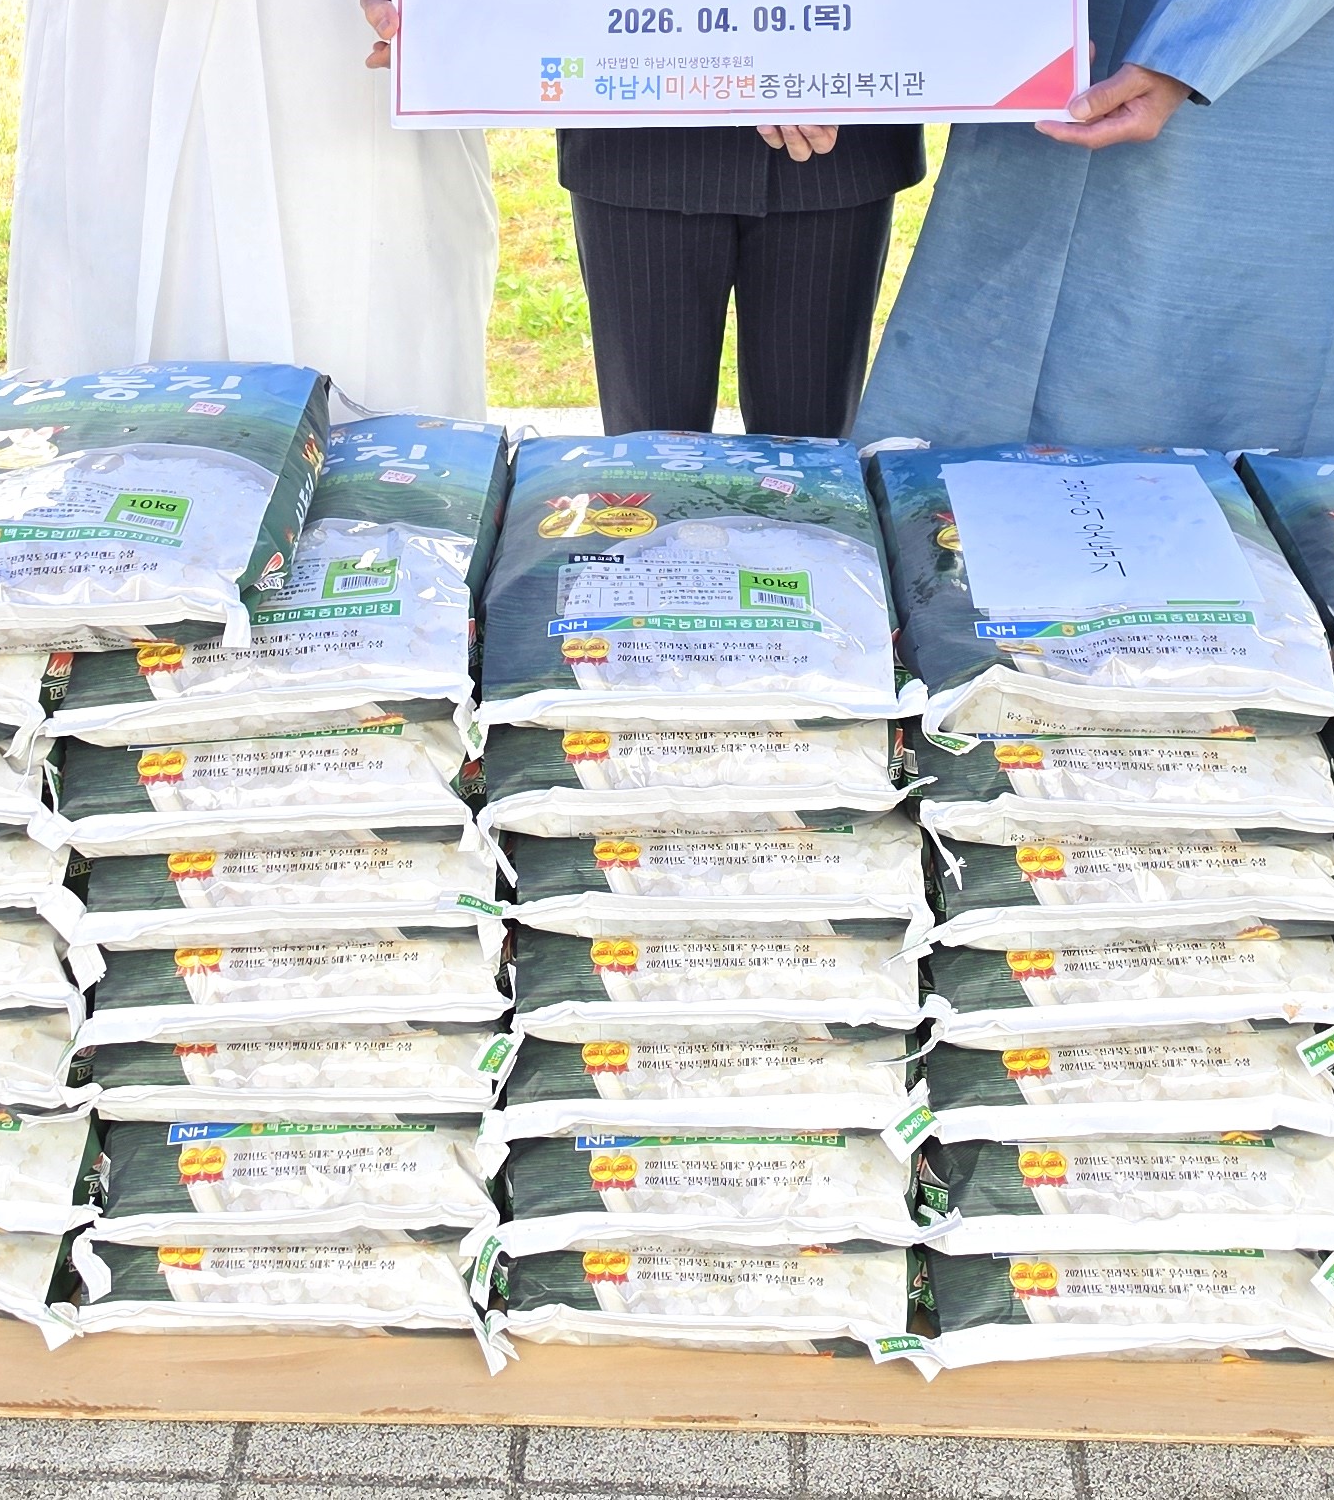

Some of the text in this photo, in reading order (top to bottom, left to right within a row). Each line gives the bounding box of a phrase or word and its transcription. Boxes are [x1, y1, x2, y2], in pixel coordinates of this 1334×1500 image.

[607, 6, 683, 34] 2026.
[697, 6, 738, 33] 04.
[595, 55, 755, 70] 사단법인 하남시민생안정후원회
[594, 70, 927, 101] 하남시미사강변종합사회복지관
[560, 442, 805, 478] 신동진
[127, 497, 179, 514] 10kg
[750, 575, 799, 591] 10kg
[257, 603, 393, 623] 농협미곡종합처리장
[557, 619, 589, 631] NH
[647, 616, 815, 631] 백구농협미곡종합처리장
[985, 622, 1018, 637] NH
[178, 1126, 209, 1139] NH
